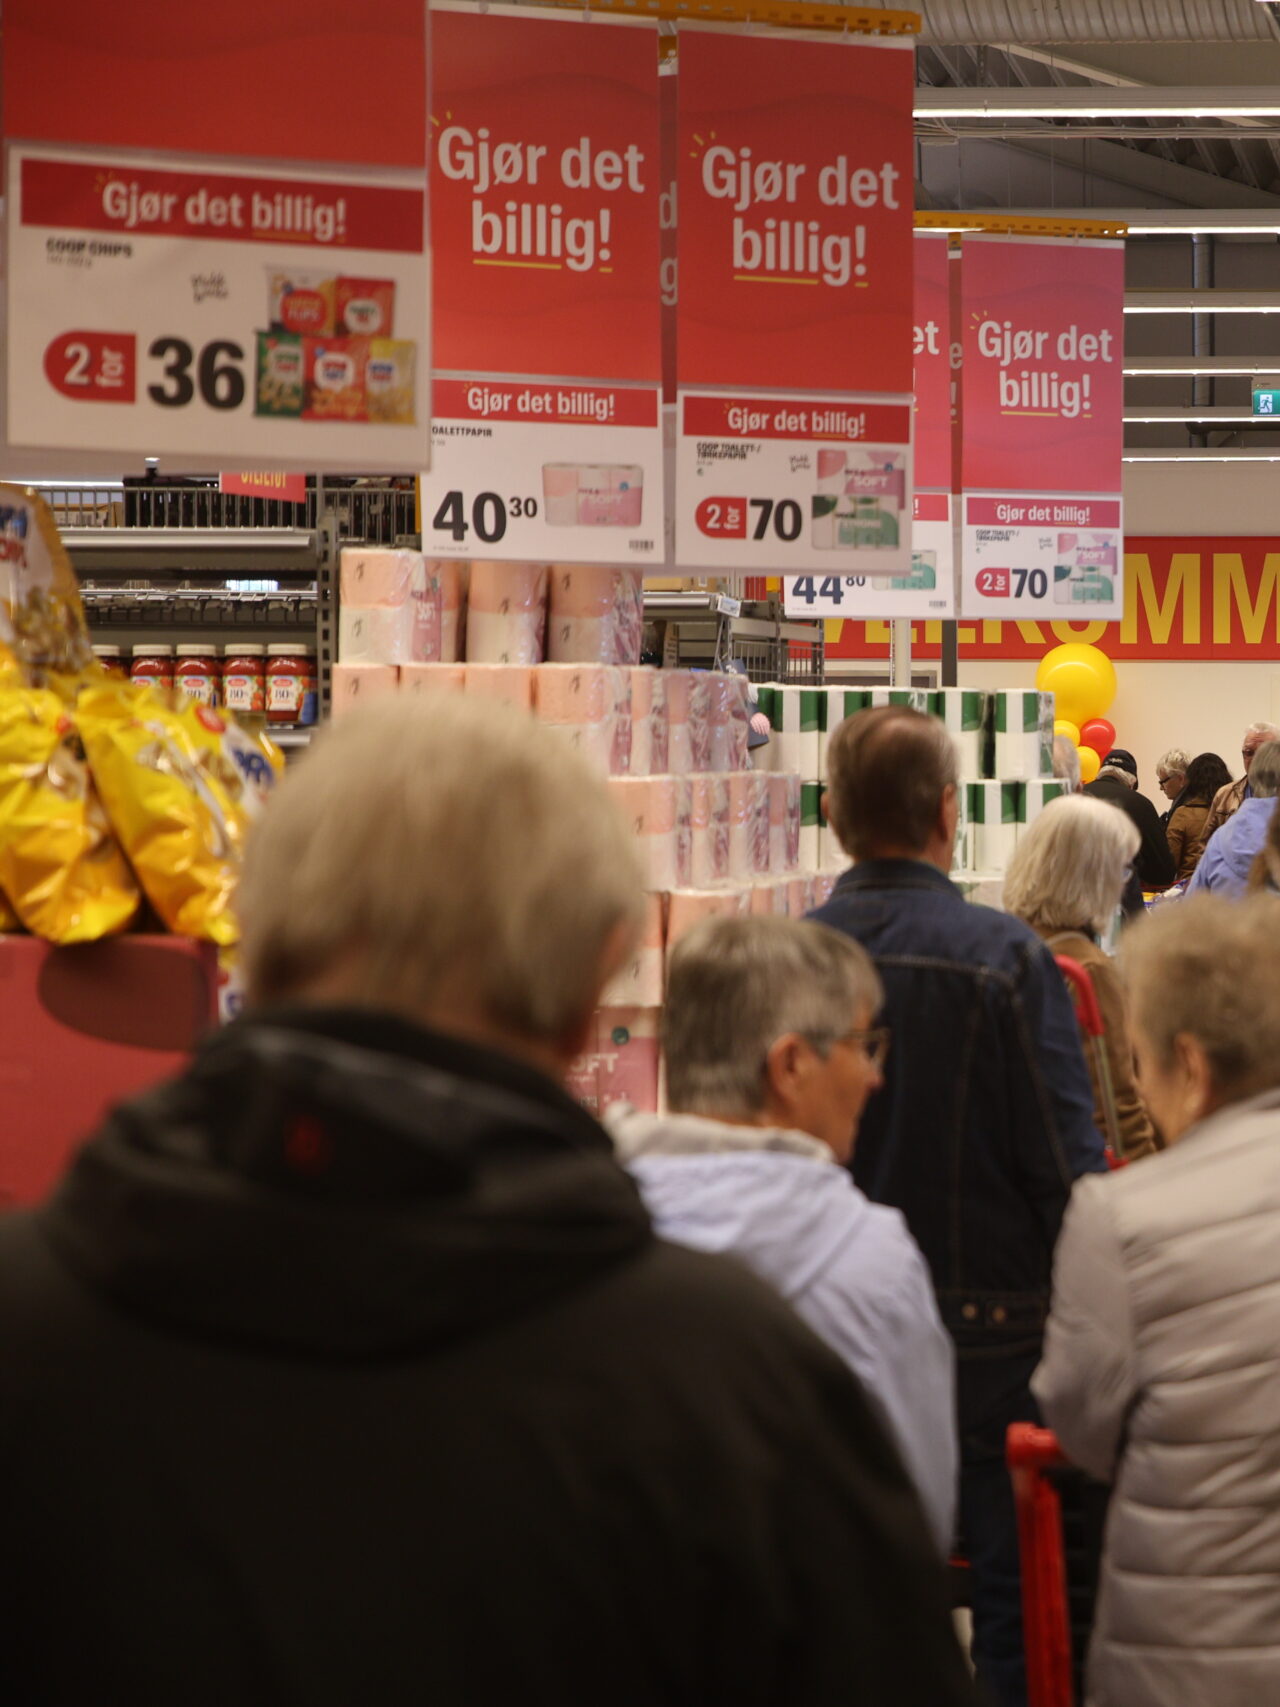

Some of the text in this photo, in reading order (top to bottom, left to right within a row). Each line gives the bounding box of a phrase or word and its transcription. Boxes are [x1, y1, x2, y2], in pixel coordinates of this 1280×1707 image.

[438, 127, 645, 194] Gjør det
[702, 146, 805, 212] Gjør
[818, 156, 899, 210] det
[102, 181, 347, 242] Gjør det billig!
[46, 237, 87, 254] COOP
[473, 200, 612, 272] billig!
[733, 218, 867, 287] billig!
[913, 321, 940, 355] et
[978, 321, 1049, 366] Gjør
[1057, 325, 1113, 362] det
[64, 343, 91, 386] 2
[95, 347, 123, 388] for
[148, 336, 246, 411] 36
[467, 386, 615, 421] Gjør det billig!
[1000, 370, 1091, 418] billig!
[432, 426, 493, 438] OALETTPAPIR
[727, 408, 866, 438] Gjør det billig!
[853, 477, 888, 488] SOFT
[433, 490, 538, 544] 40 30
[706, 499, 803, 541] 2 for 70
[997, 504, 1090, 525] Gjør det billig!
[792, 575, 866, 604] 44 80
[982, 573, 993, 591] 2
[1011, 568, 1048, 599] 70
[570, 1052, 619, 1074] OFT
